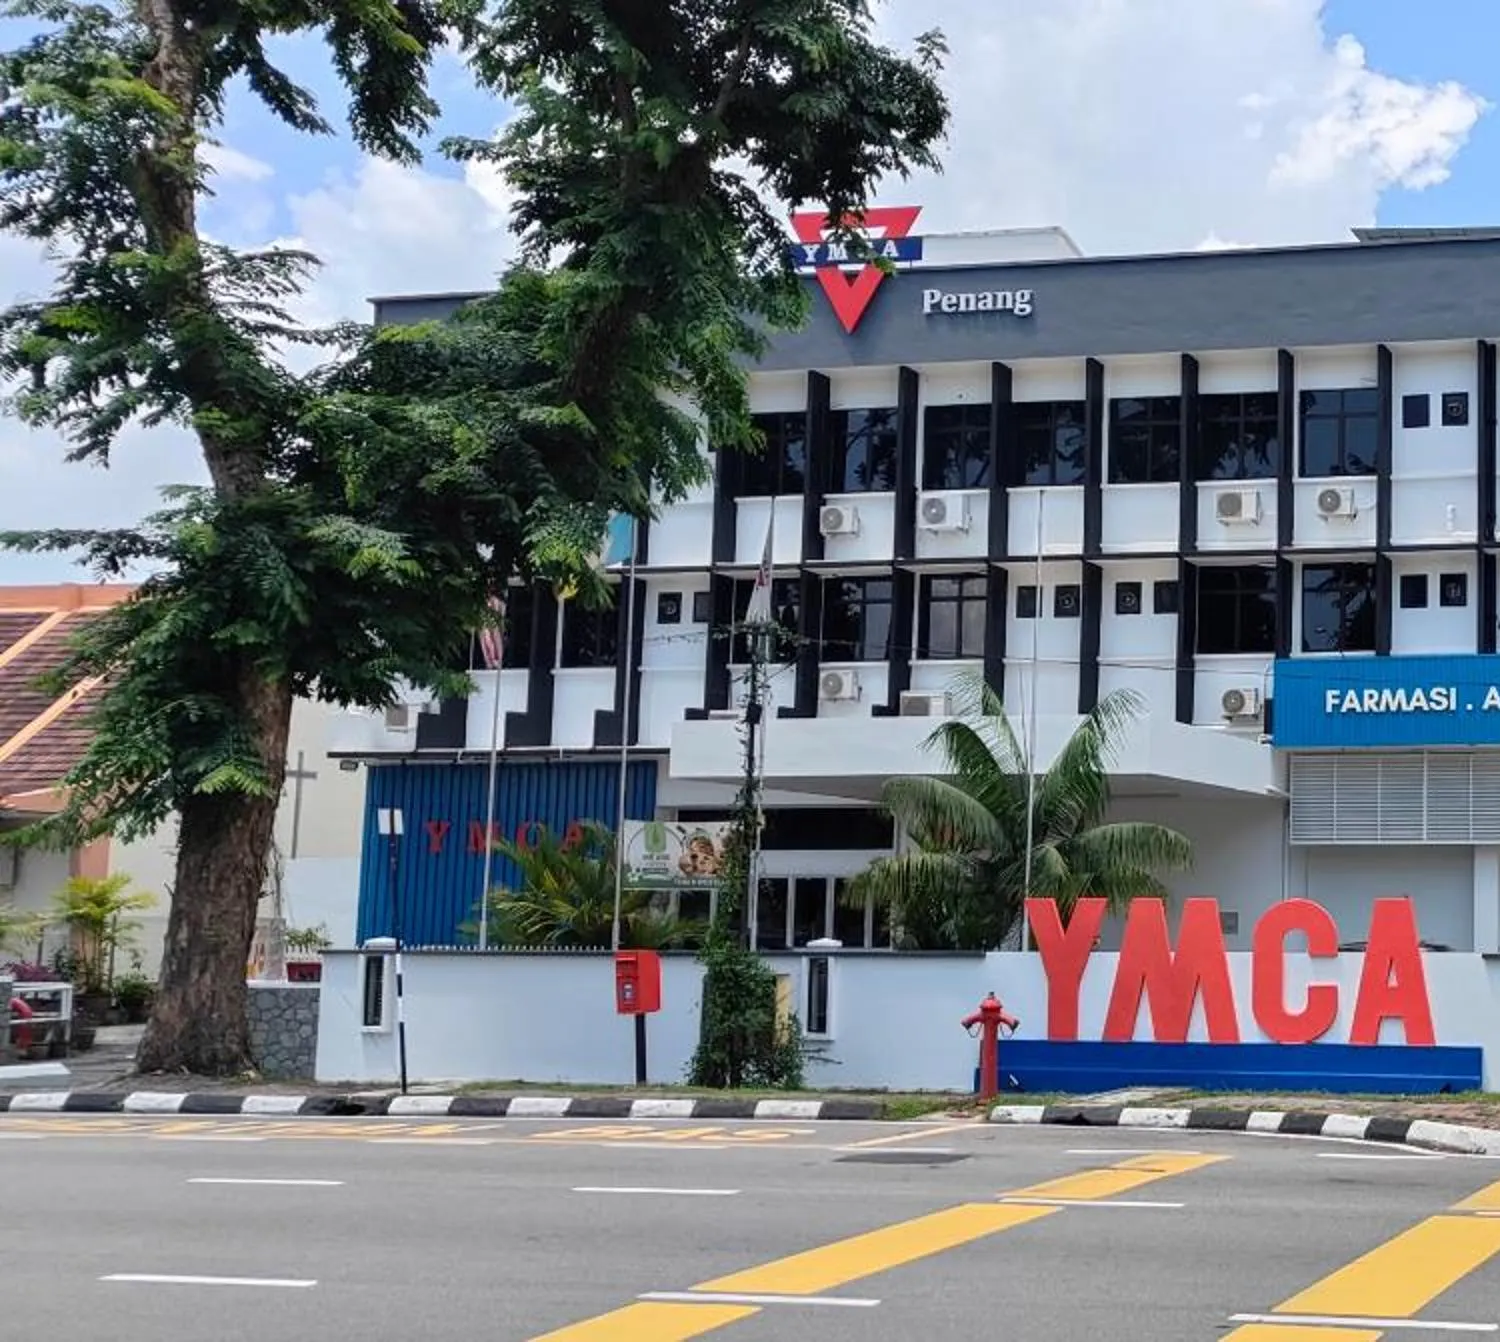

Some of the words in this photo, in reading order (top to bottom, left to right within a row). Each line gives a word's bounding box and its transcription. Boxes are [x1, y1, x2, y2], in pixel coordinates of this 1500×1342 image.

[922, 288, 1034, 317] Penang
[1325, 686, 1457, 713] FARMASI
[1025, 897, 1436, 1046] YMCA
